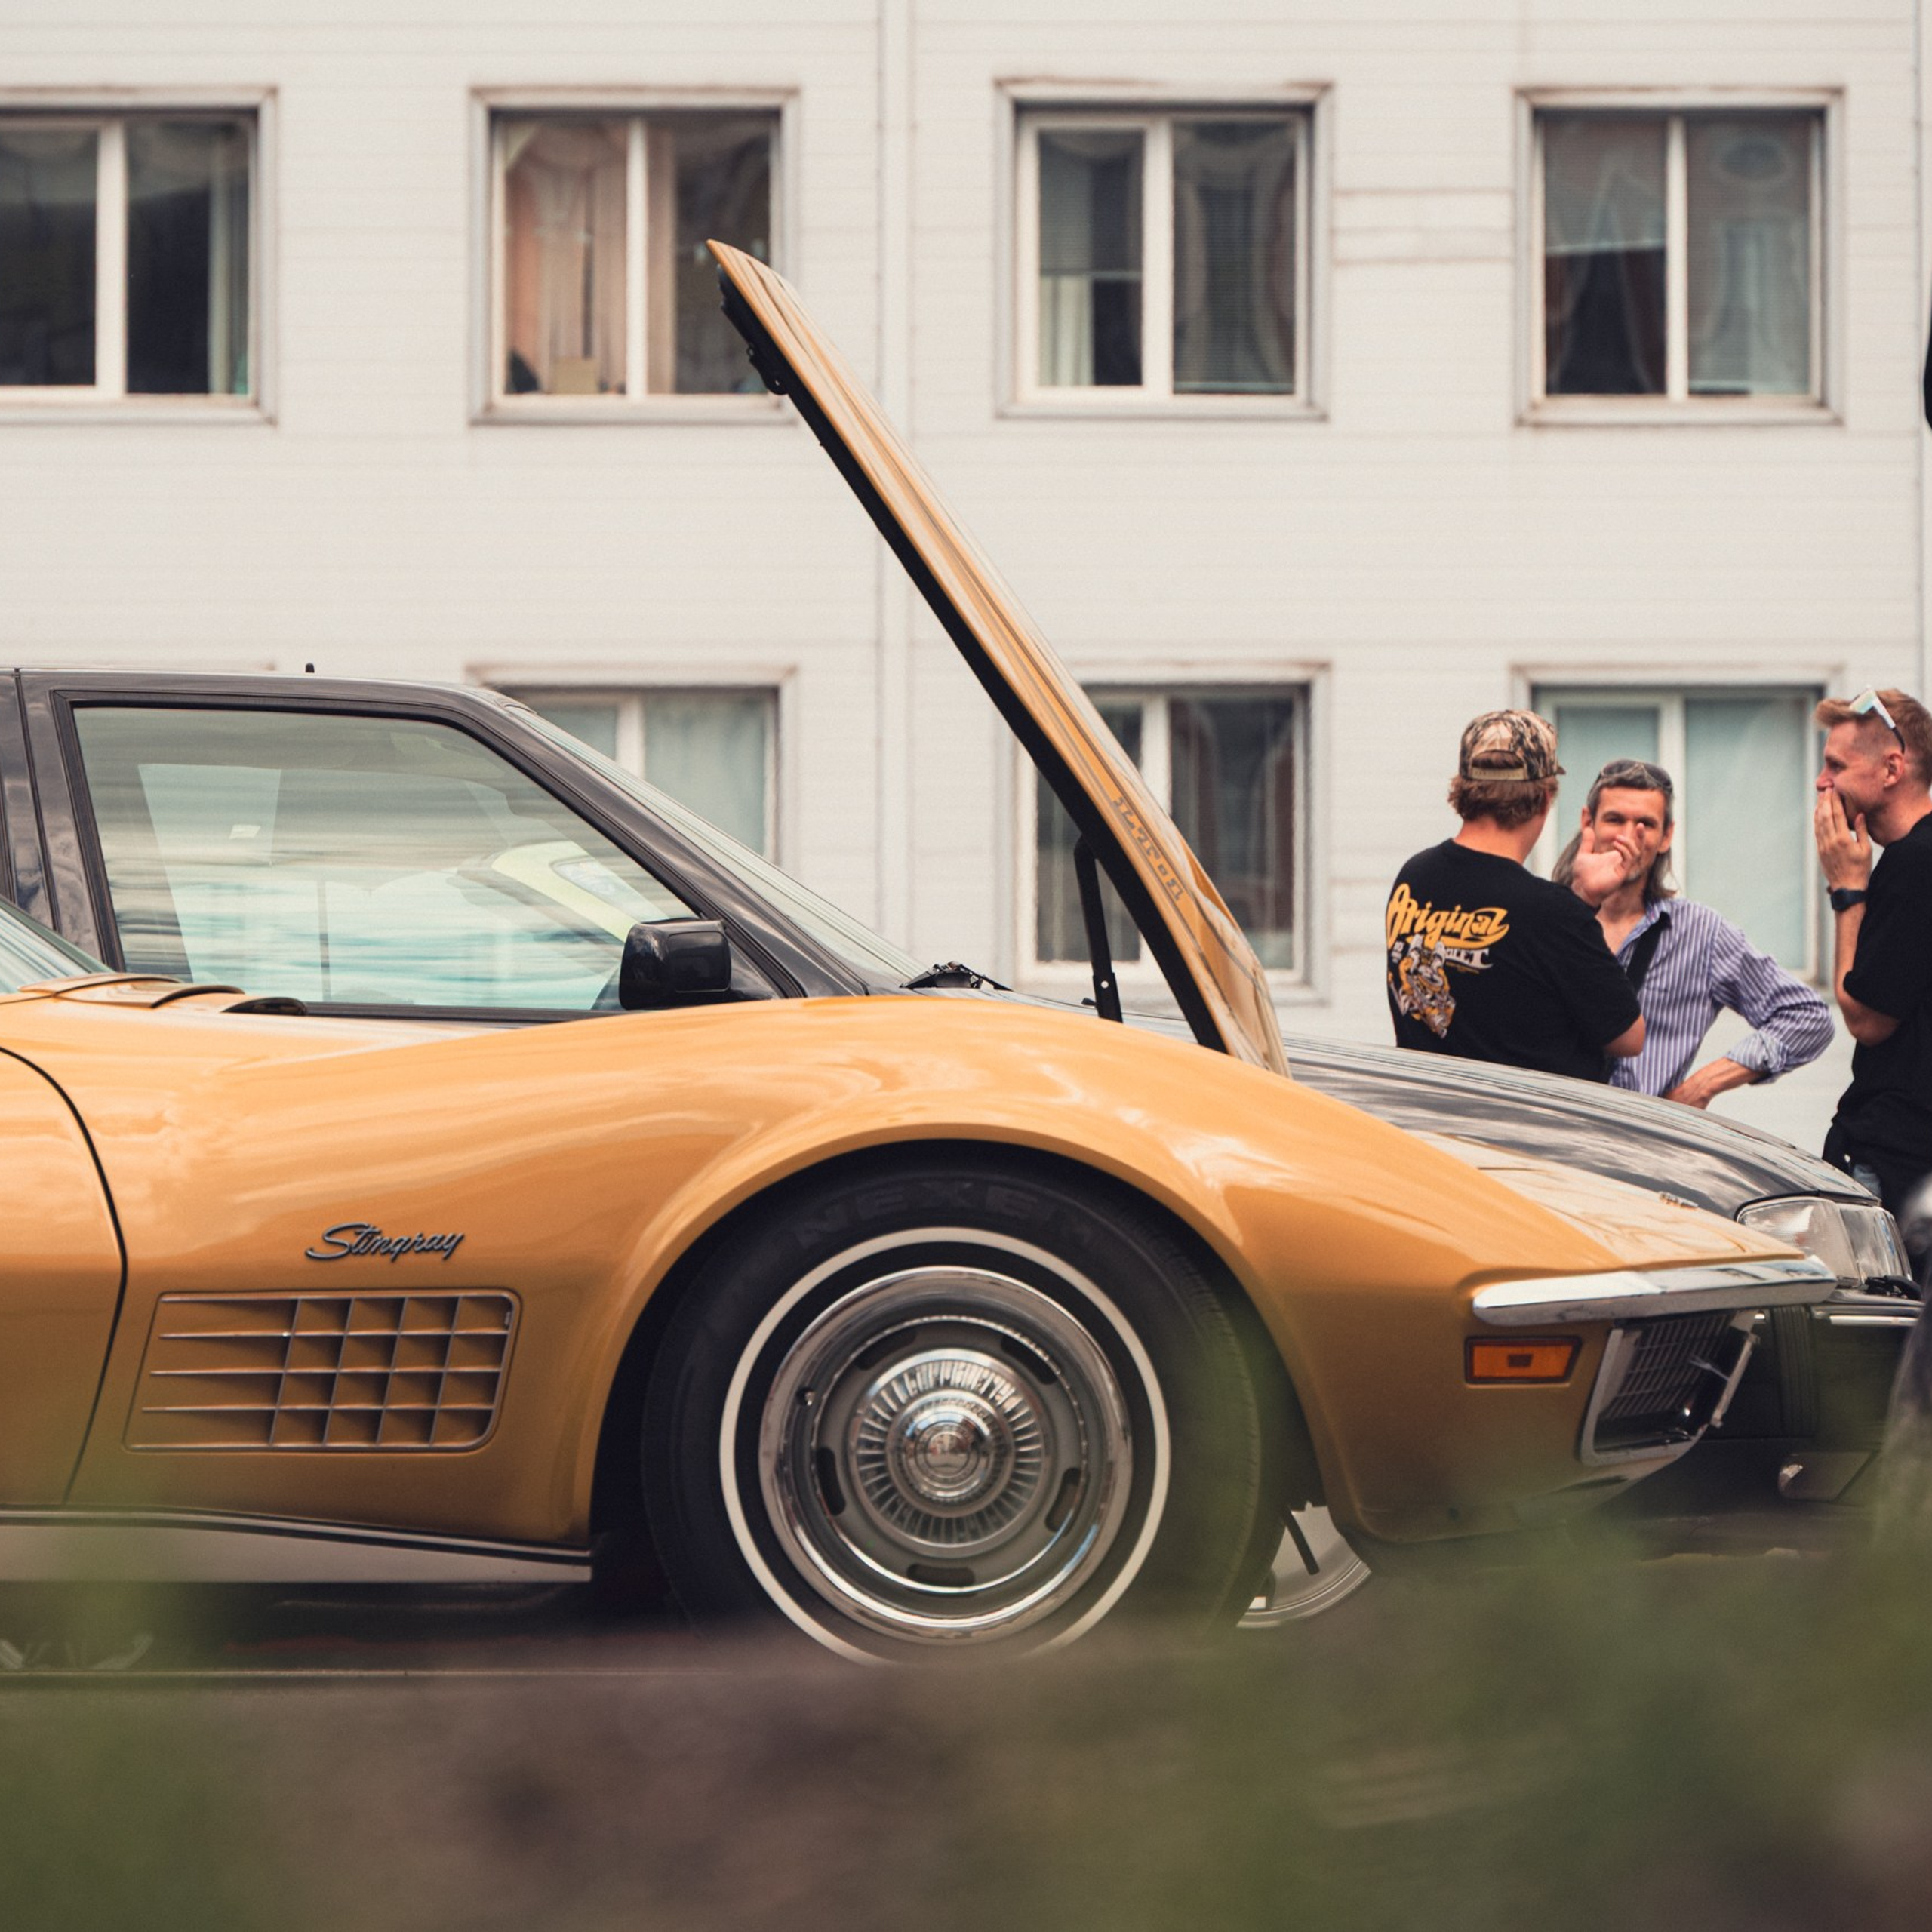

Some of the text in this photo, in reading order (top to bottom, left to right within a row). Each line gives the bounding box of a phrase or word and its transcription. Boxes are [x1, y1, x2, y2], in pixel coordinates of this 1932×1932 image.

[1386, 883, 1510, 950] Original
[305, 1222, 465, 1263] Stingray
[795, 1180, 1099, 1250] NEXEN
